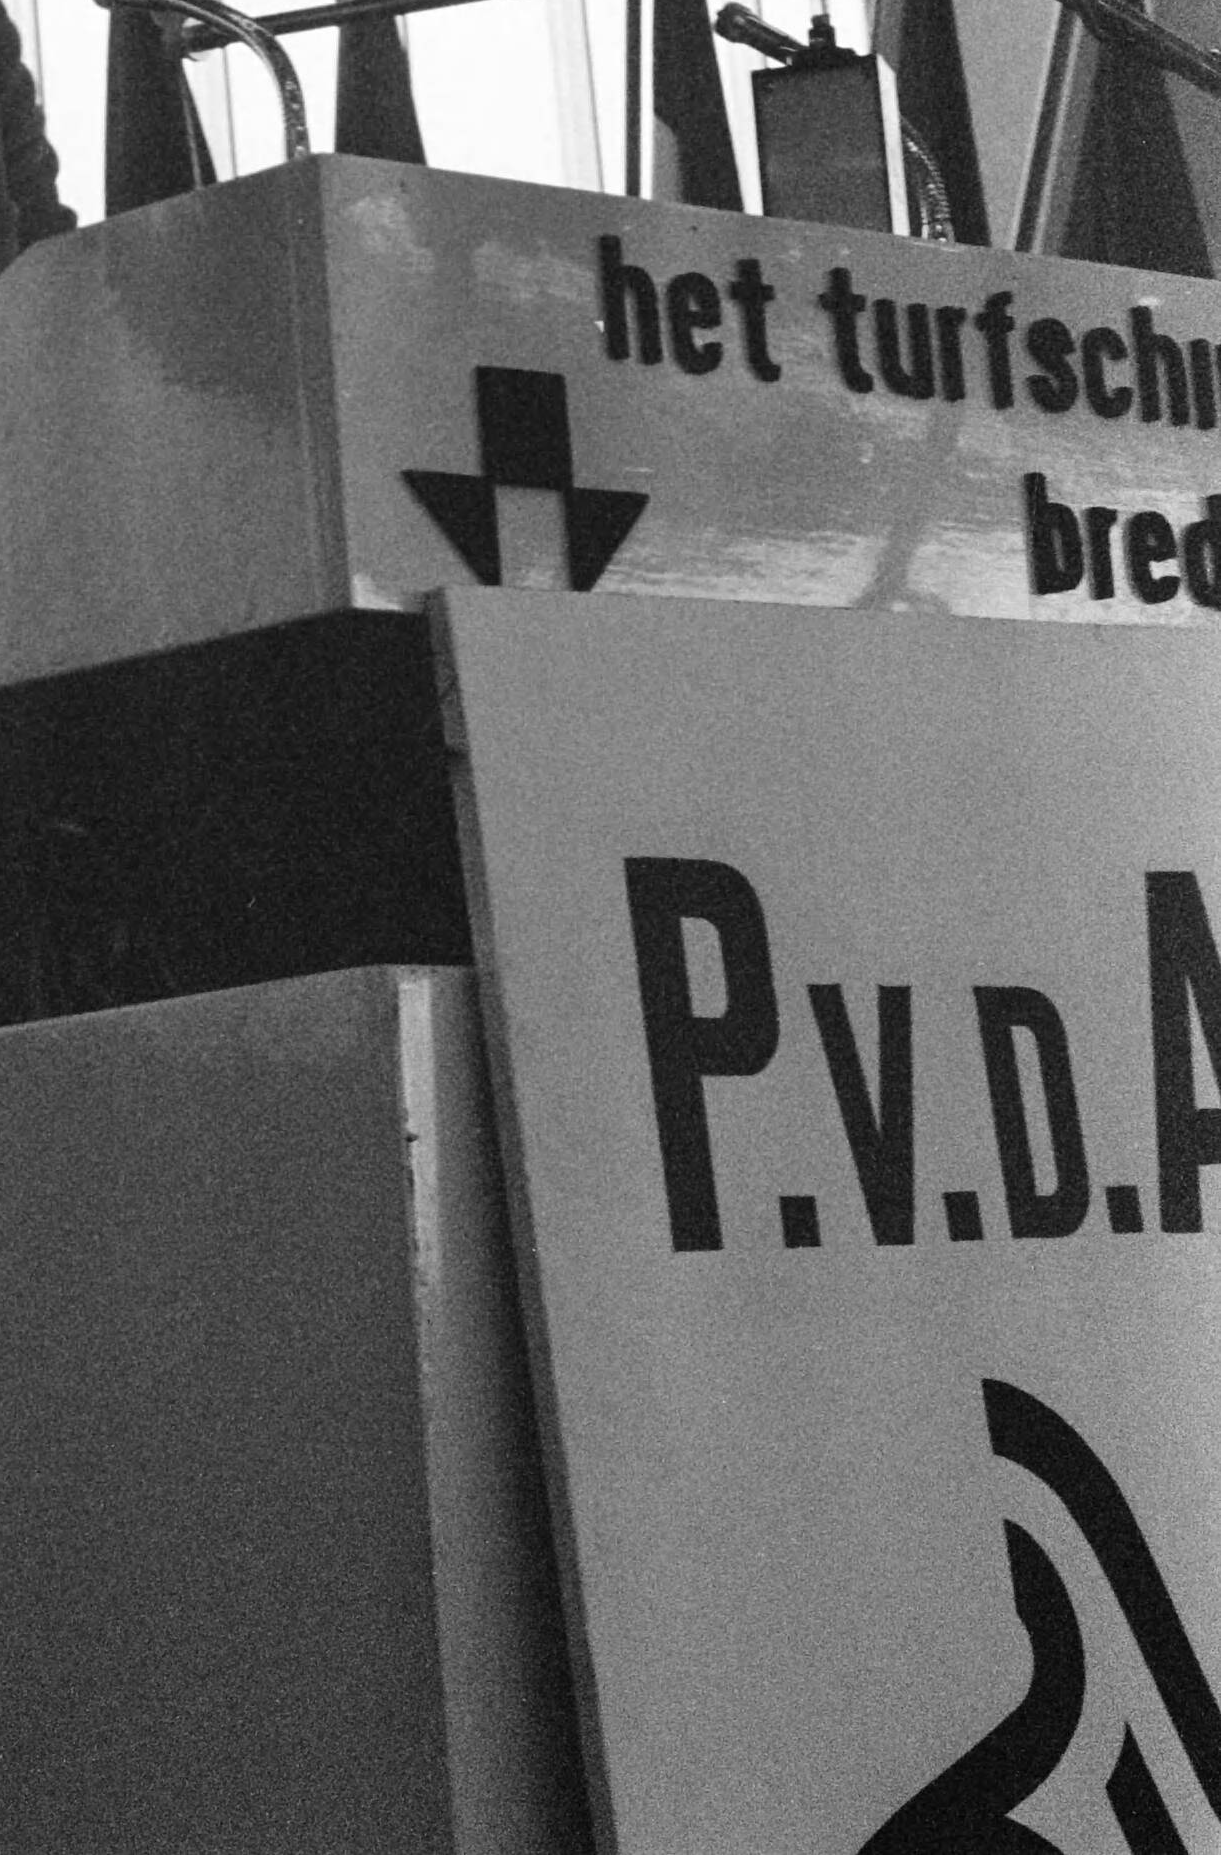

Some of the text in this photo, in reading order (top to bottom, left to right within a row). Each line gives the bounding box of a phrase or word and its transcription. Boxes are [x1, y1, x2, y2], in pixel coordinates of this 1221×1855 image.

[599, 235, 1221, 430] het turfschi
[1023, 472, 1221, 612] bred
